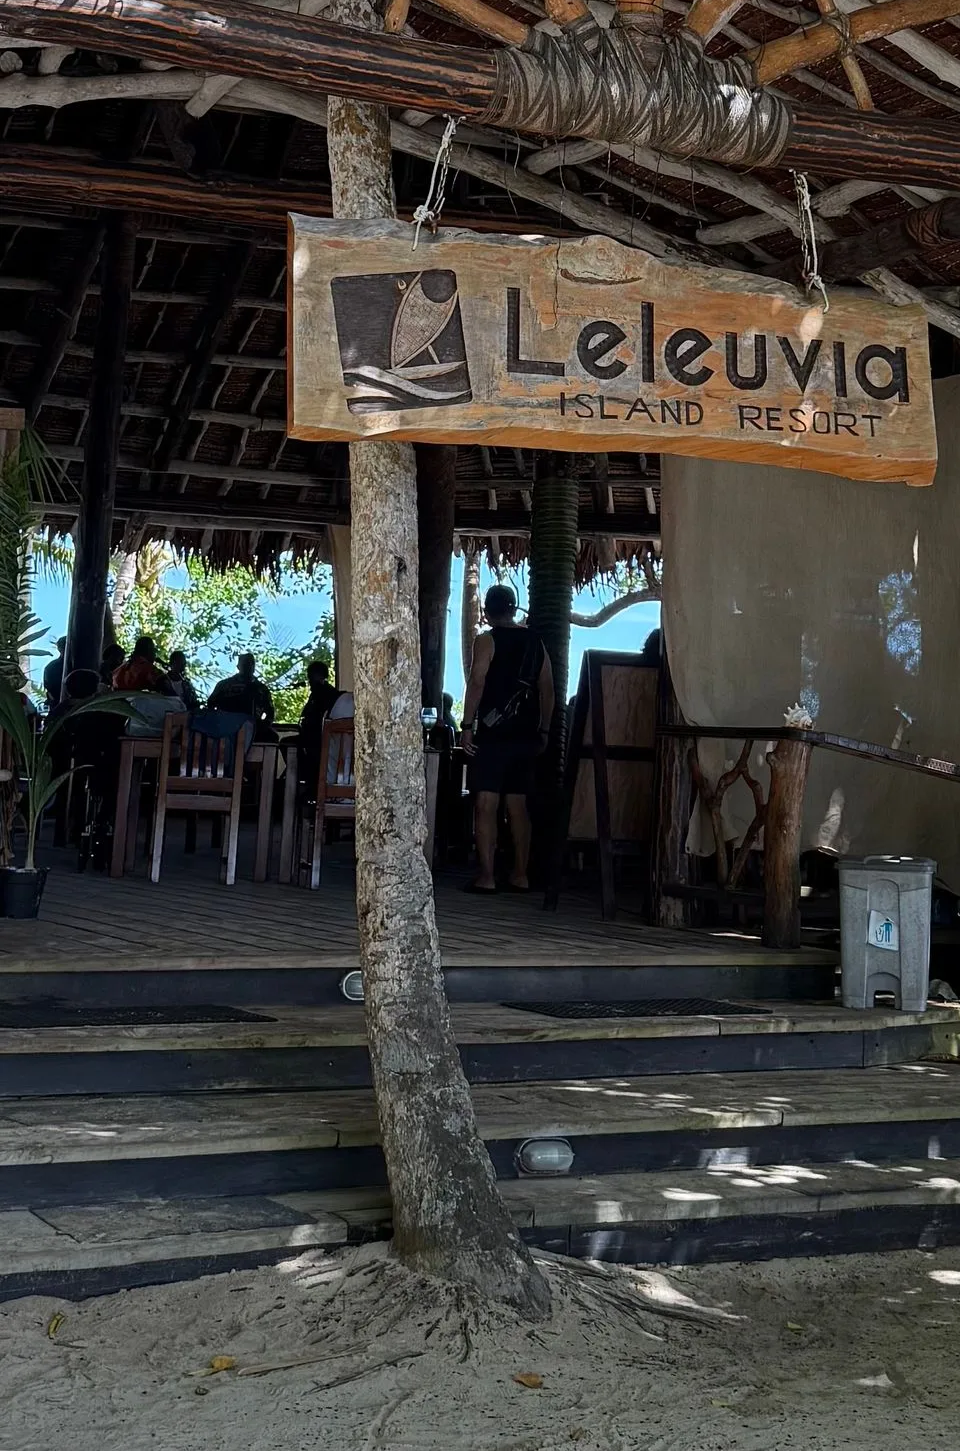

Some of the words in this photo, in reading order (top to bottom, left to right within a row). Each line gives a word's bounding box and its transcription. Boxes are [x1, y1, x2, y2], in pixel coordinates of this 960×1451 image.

[507, 286, 910, 403] Leleuvia
[560, 391, 704, 426] ISLAND
[738, 405, 882, 437] RESORT
